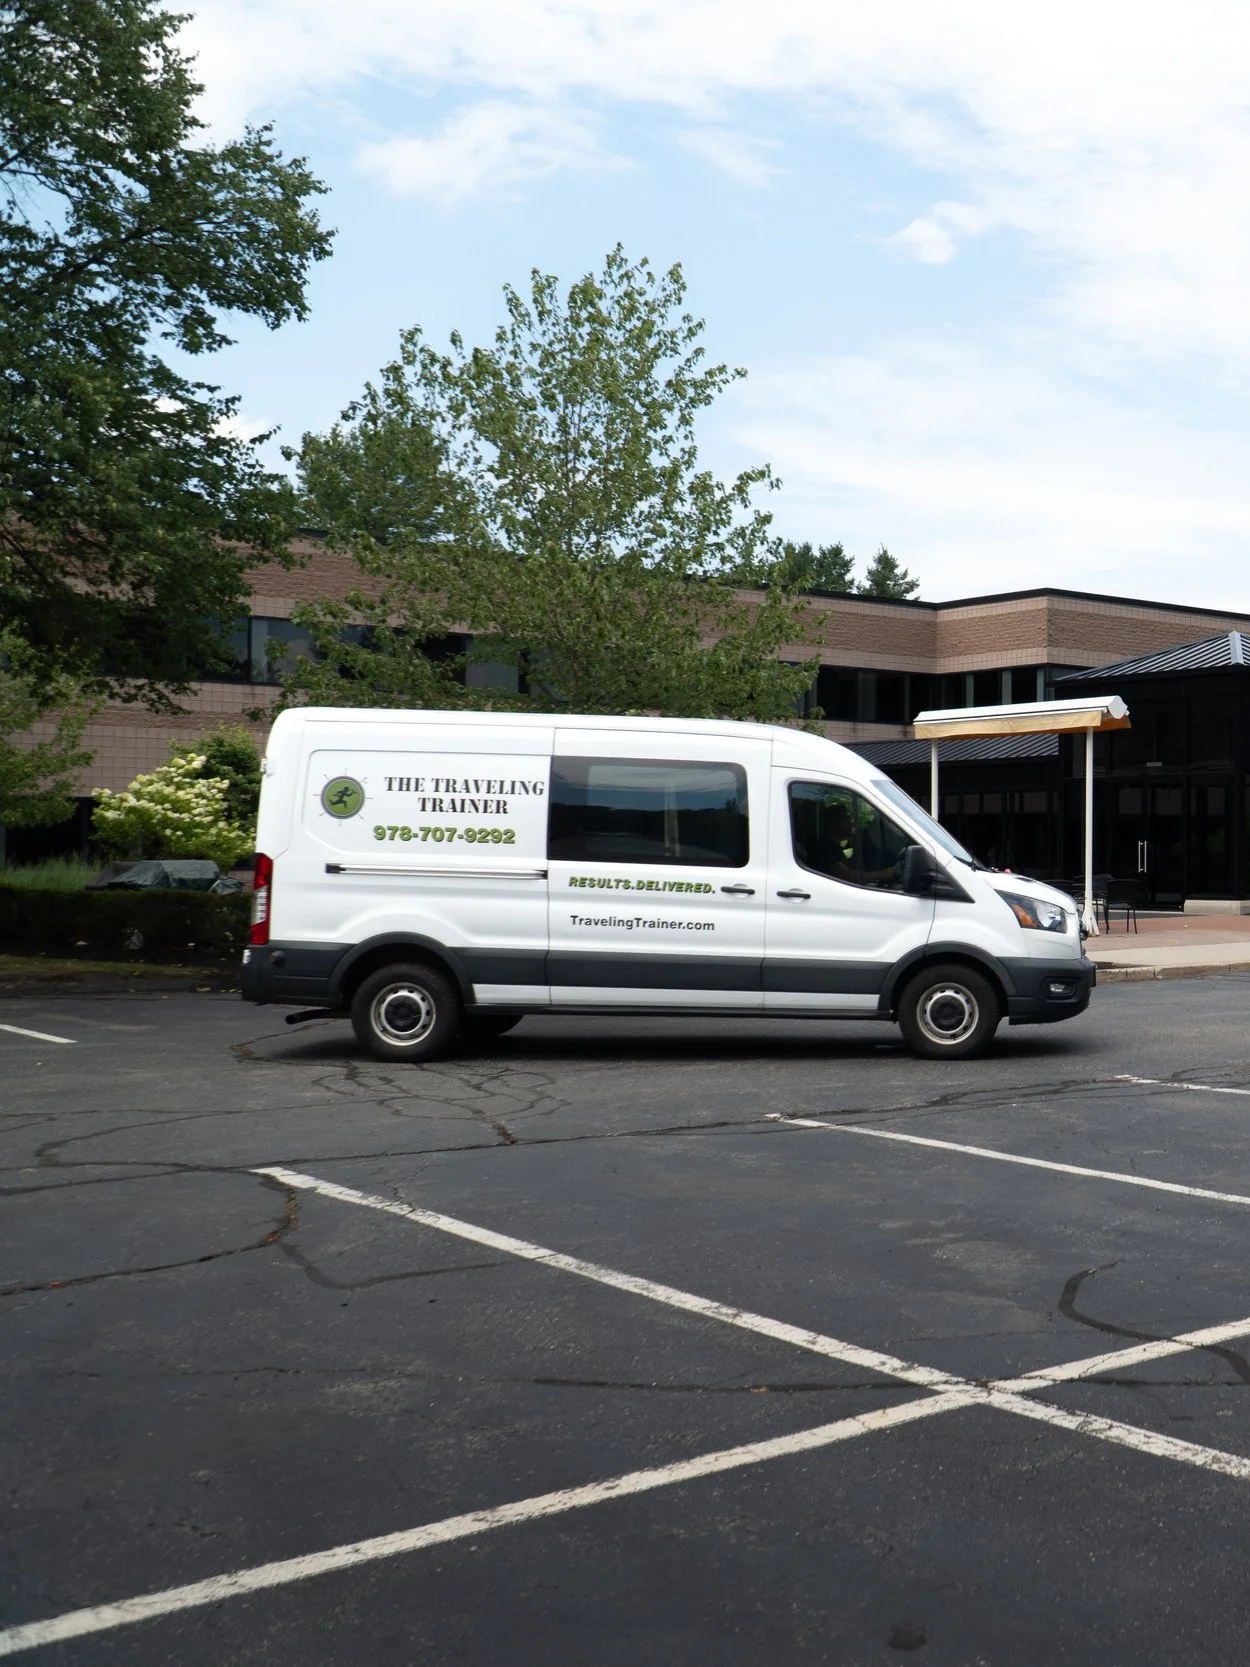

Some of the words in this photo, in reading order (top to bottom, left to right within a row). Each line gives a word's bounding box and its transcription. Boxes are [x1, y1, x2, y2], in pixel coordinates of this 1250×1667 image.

[384, 776, 425, 792] THE
[431, 777, 545, 796] TRAVELING
[417, 797, 509, 815] TRAINER
[373, 825, 516, 844] 978-707-9292
[568, 876, 716, 894] RESULTS.DELIVERED.
[570, 915, 715, 930] TravelingTrainer.com
